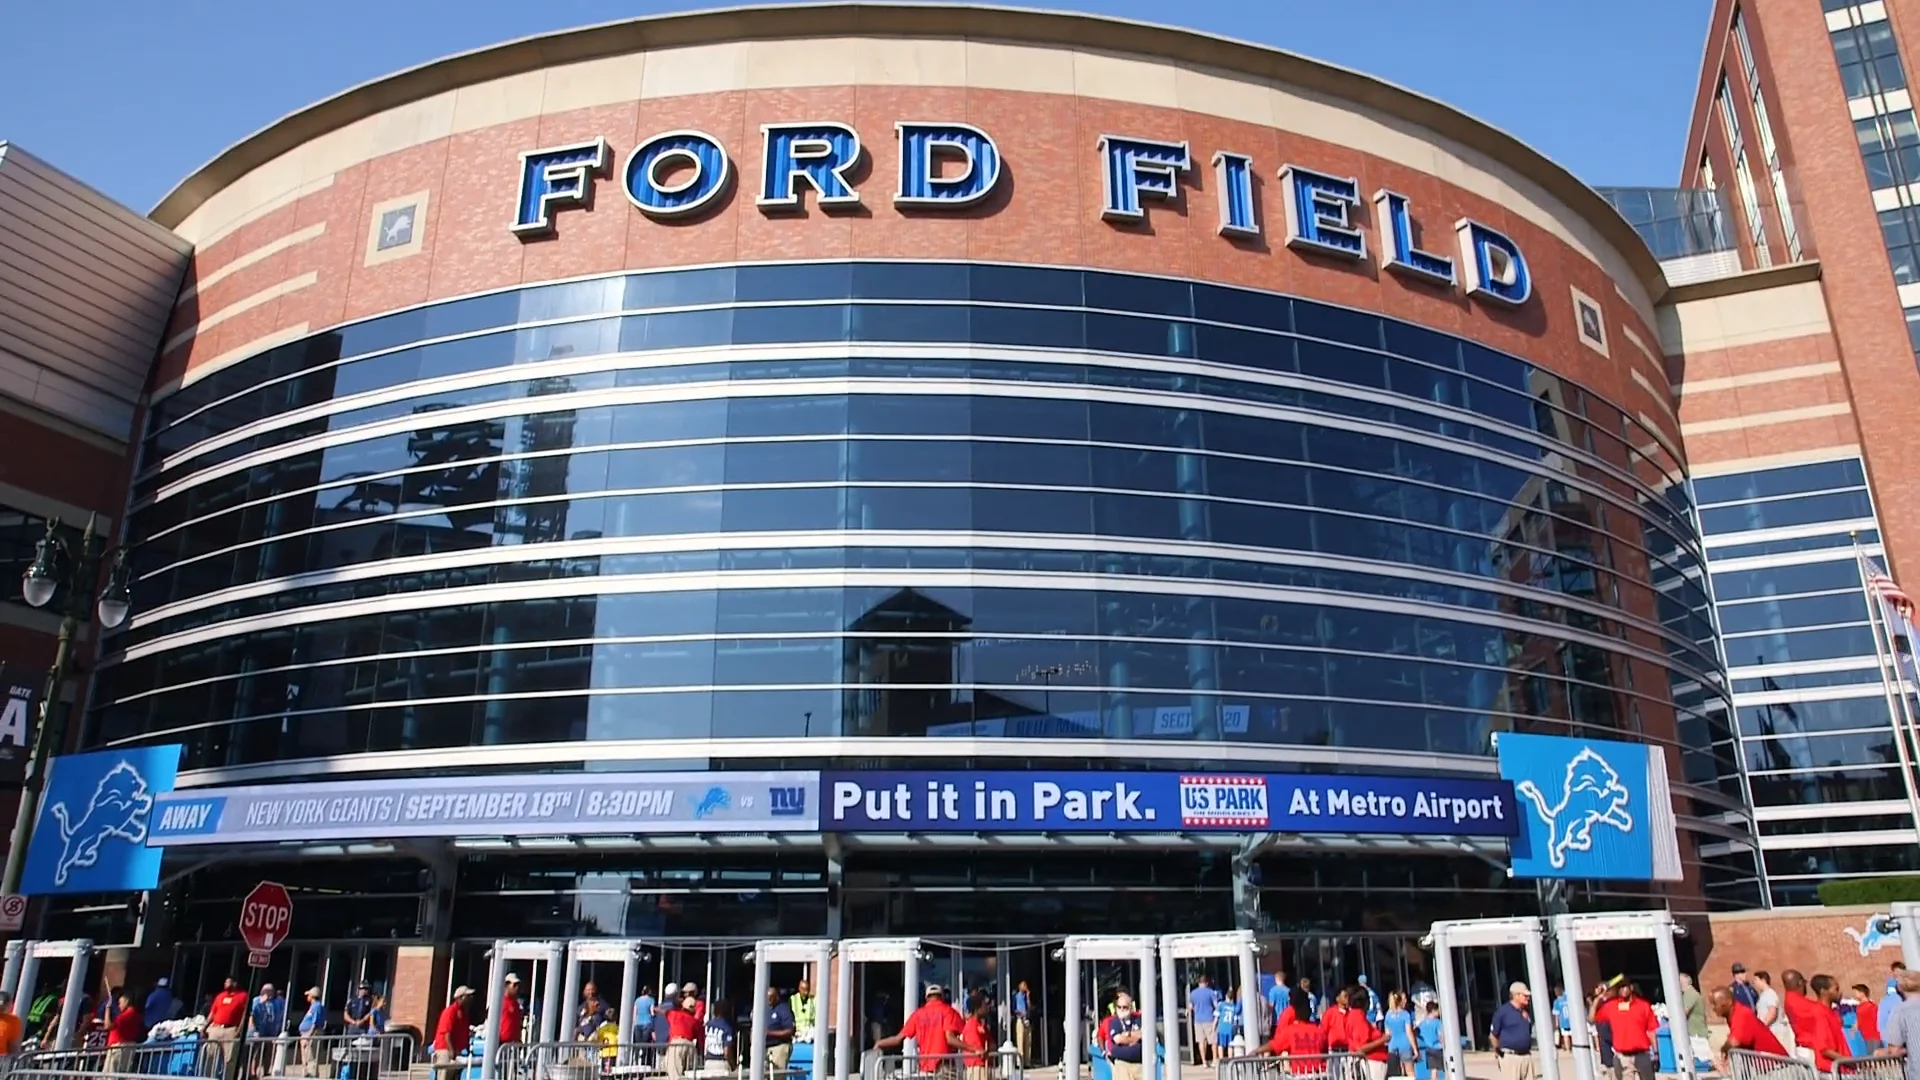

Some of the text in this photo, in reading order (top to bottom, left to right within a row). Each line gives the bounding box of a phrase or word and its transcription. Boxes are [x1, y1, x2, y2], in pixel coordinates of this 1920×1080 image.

[508, 120, 1532, 306] FORD FIELD
[0, 698, 27, 746] A
[158, 803, 213, 831] AWAY
[245, 789, 676, 826] NEW YORK GIANTS SEPTEMBER 18TH 8:30PM
[833, 781, 1156, 821] Put it in Park.
[1184, 787, 1263, 811] US PARK
[1289, 788, 1504, 824] At Metro Airport
[244, 902, 289, 931] STOP
